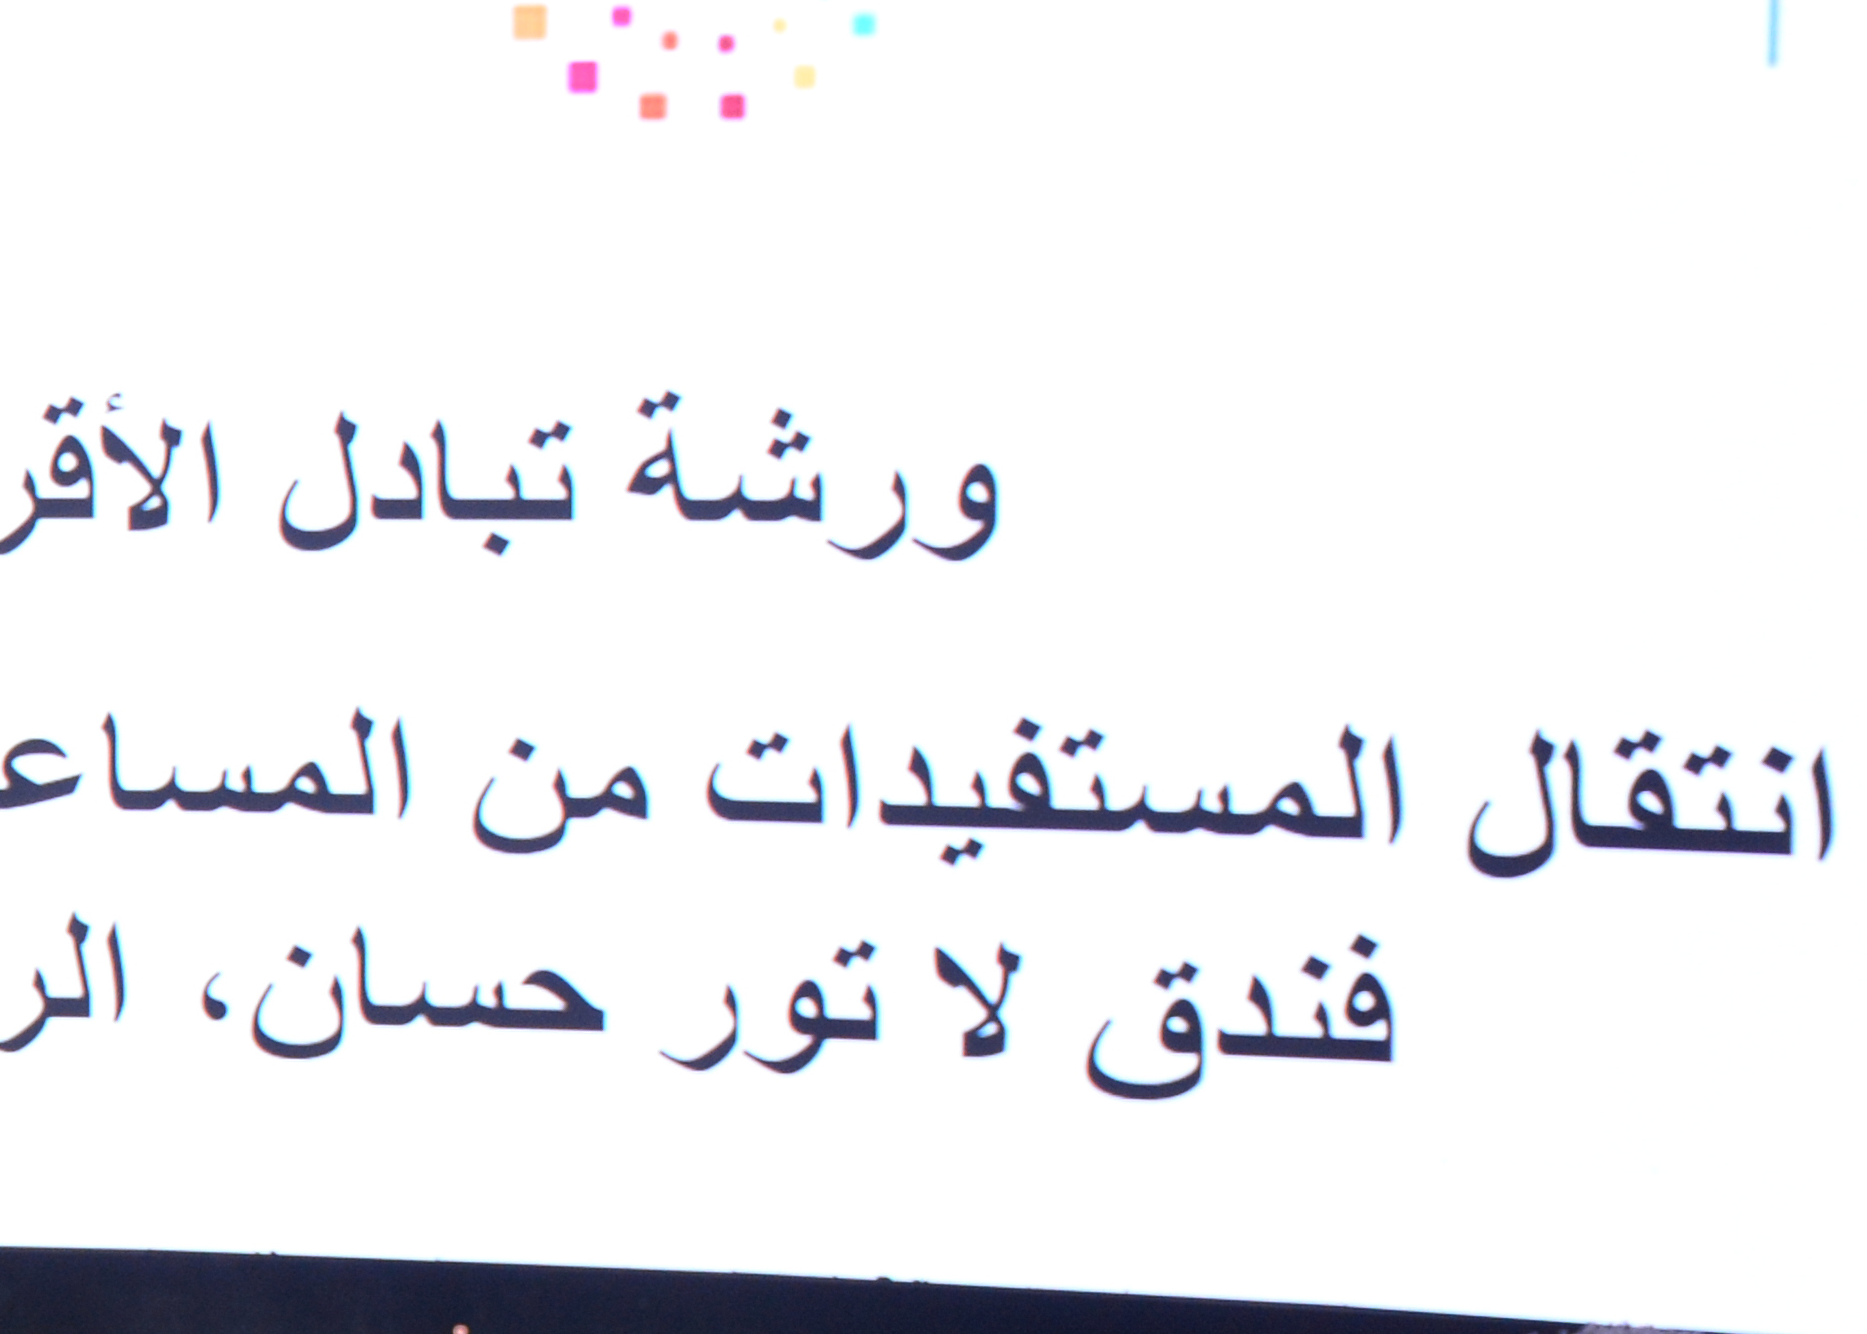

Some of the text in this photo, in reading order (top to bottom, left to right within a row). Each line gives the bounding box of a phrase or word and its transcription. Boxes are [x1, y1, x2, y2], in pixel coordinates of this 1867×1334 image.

[281, 415, 576, 556] تبادل
[629, 393, 999, 562] ورشة
[475, 741, 650, 854] من
[708, 720, 1404, 866] المستفيدات
[1469, 732, 1835, 879] انتقال
[661, 943, 880, 1075] تور
[936, 947, 1023, 1058] لا
[1088, 936, 1394, 1101] فندق
